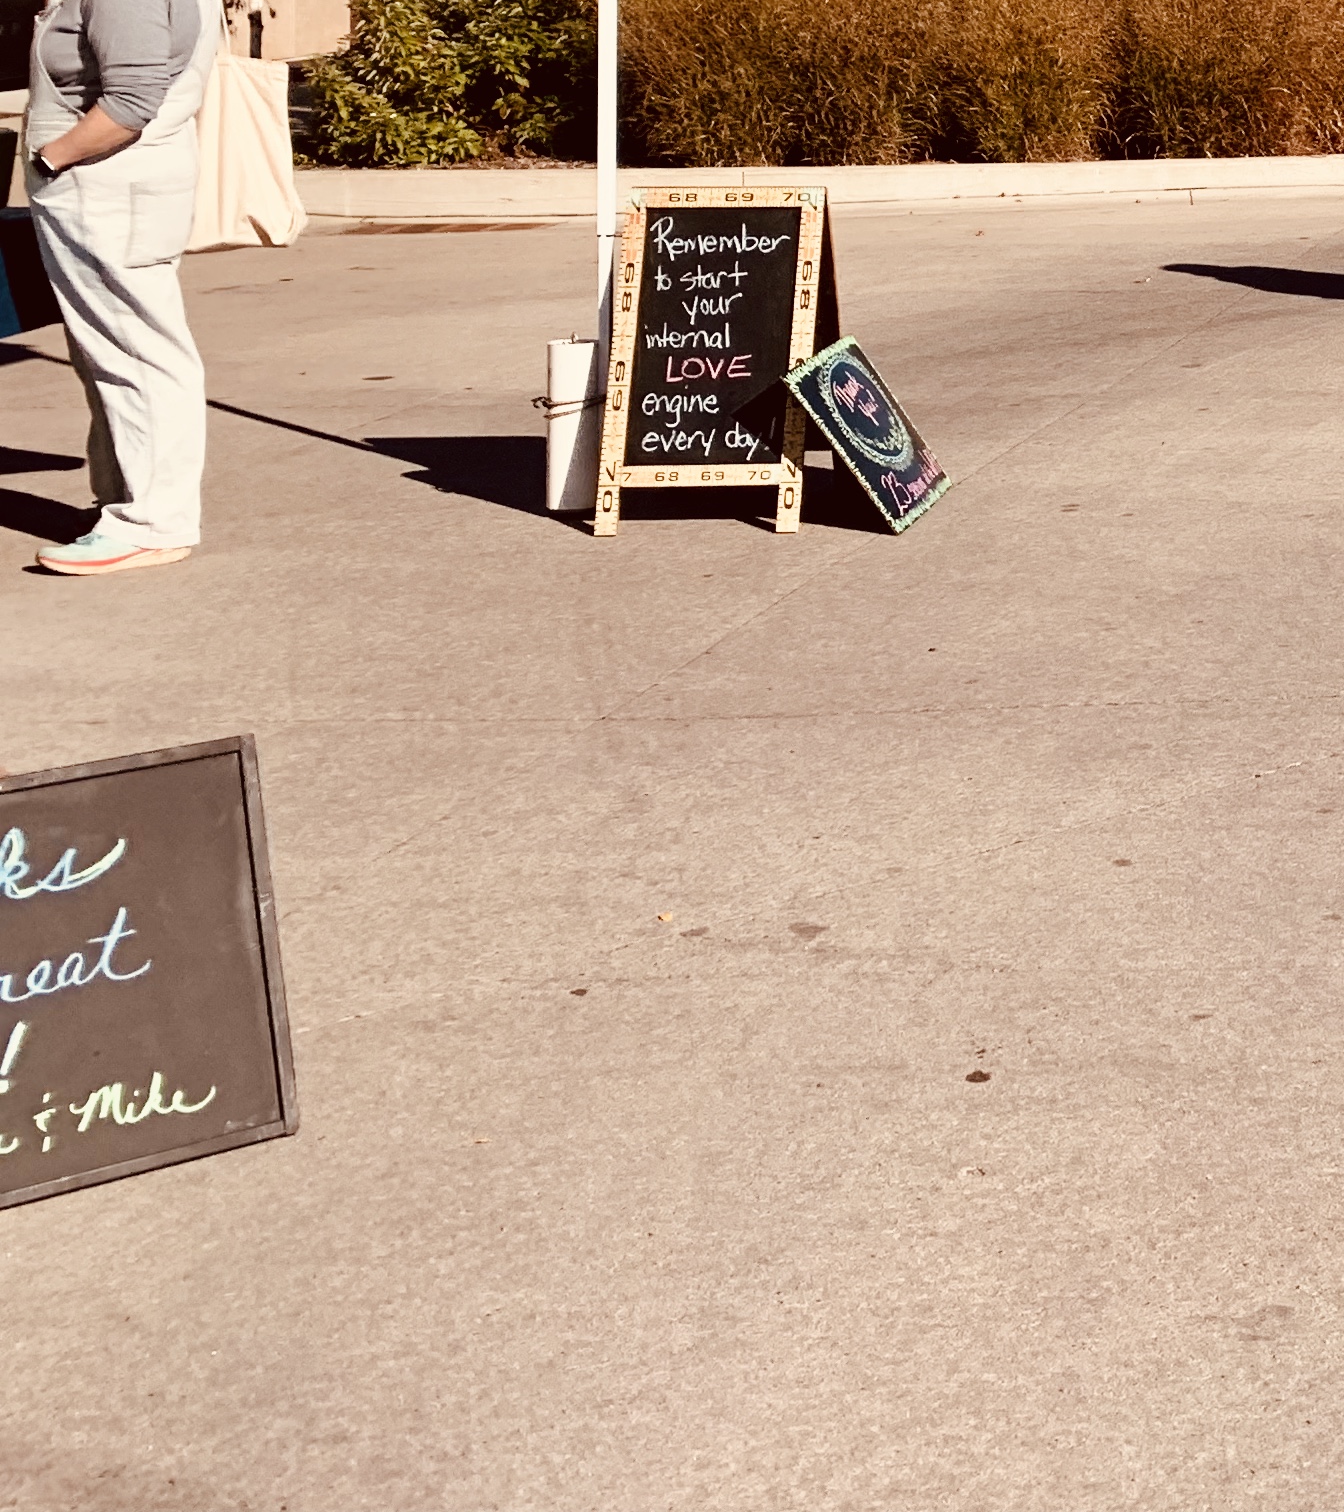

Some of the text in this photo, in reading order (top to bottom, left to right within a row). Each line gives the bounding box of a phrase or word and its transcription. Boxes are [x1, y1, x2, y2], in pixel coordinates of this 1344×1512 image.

[649, 215, 791, 262] Remember
[653, 260, 749, 292] to start
[681, 292, 743, 325] your
[643, 322, 732, 350] internal
[665, 354, 753, 383] LOVE
[641, 385, 720, 428] engine
[641, 428, 716, 457] every
[68, 1070, 218, 1133] Mike
